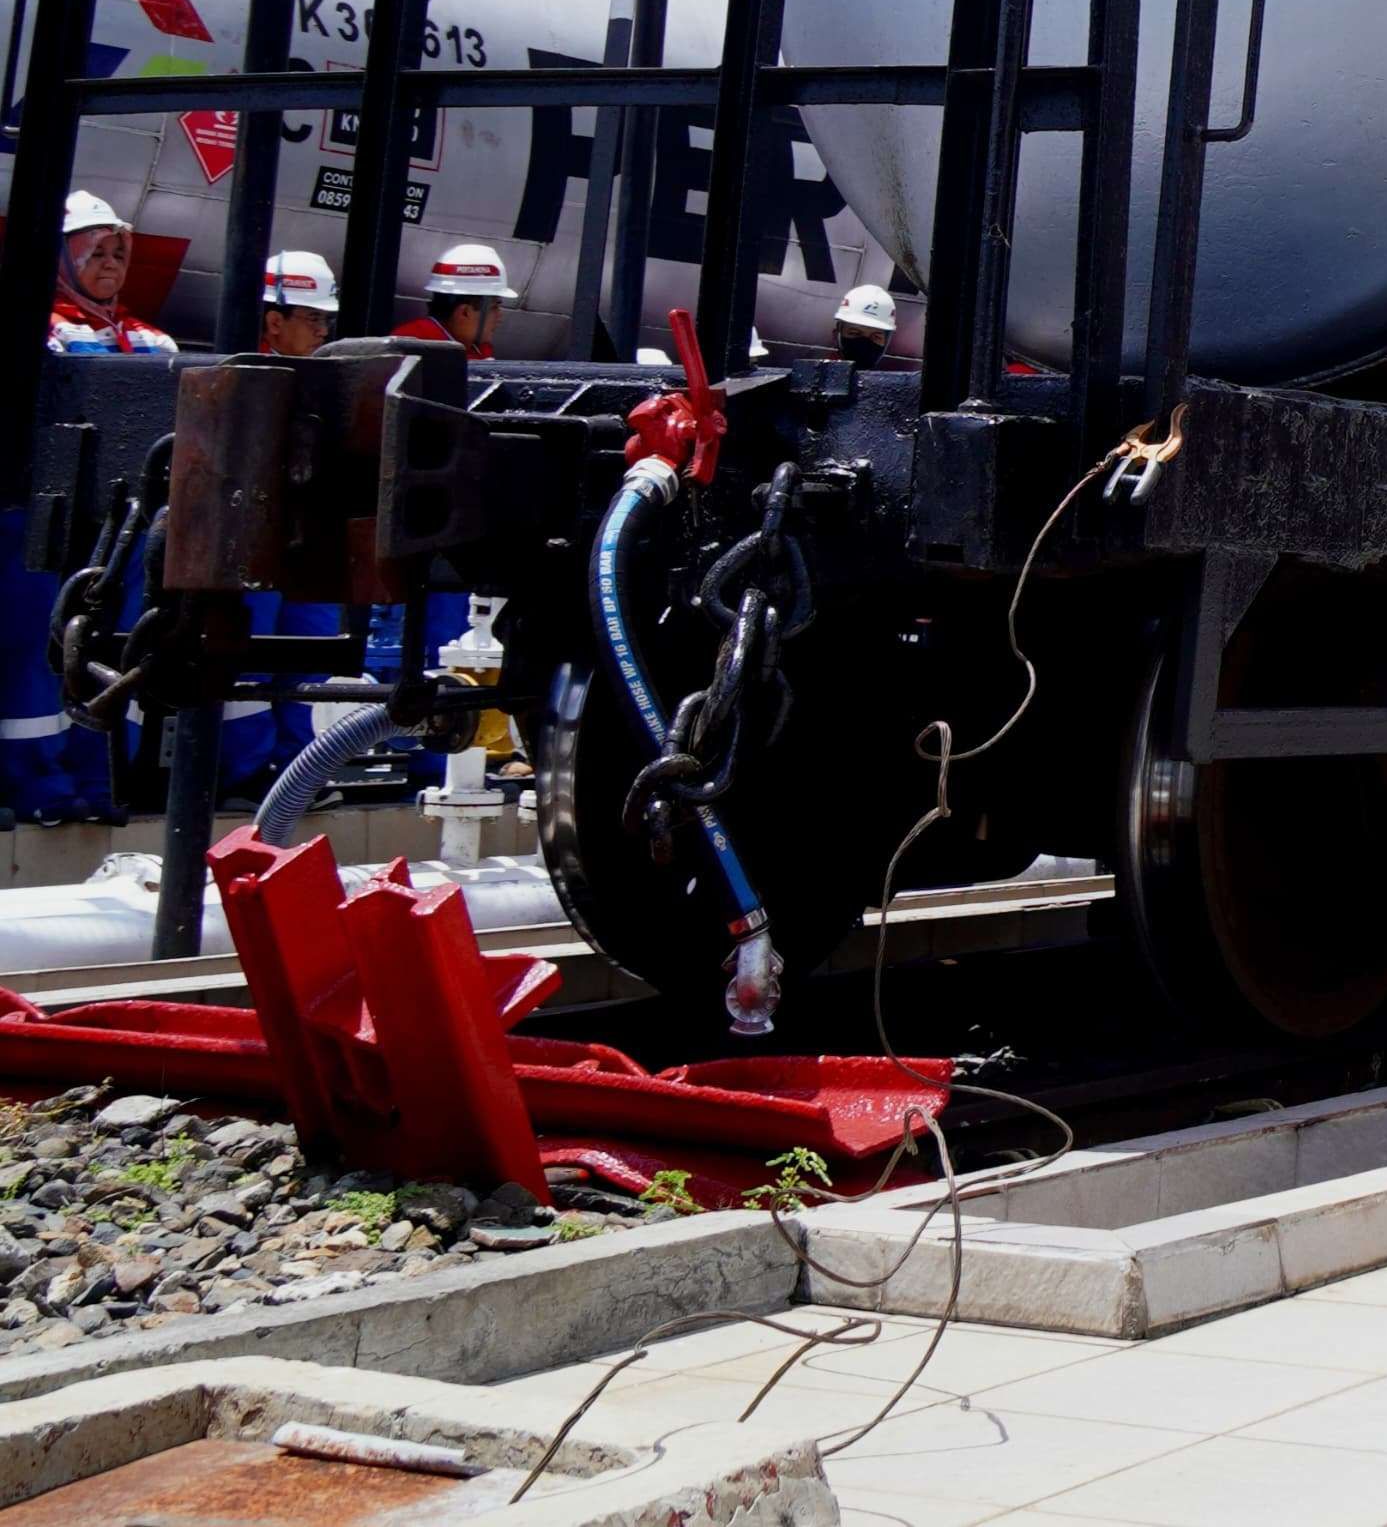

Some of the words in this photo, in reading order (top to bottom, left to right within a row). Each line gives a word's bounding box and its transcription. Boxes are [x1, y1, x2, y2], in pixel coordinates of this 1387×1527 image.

[317, 190, 350, 208] 0859
[600, 550, 613, 576] BAR
[602, 596, 617, 613] BP
[607, 616, 623, 642] BAR
[619, 660, 637, 680] WP
[629, 680, 652, 714] HOSE
